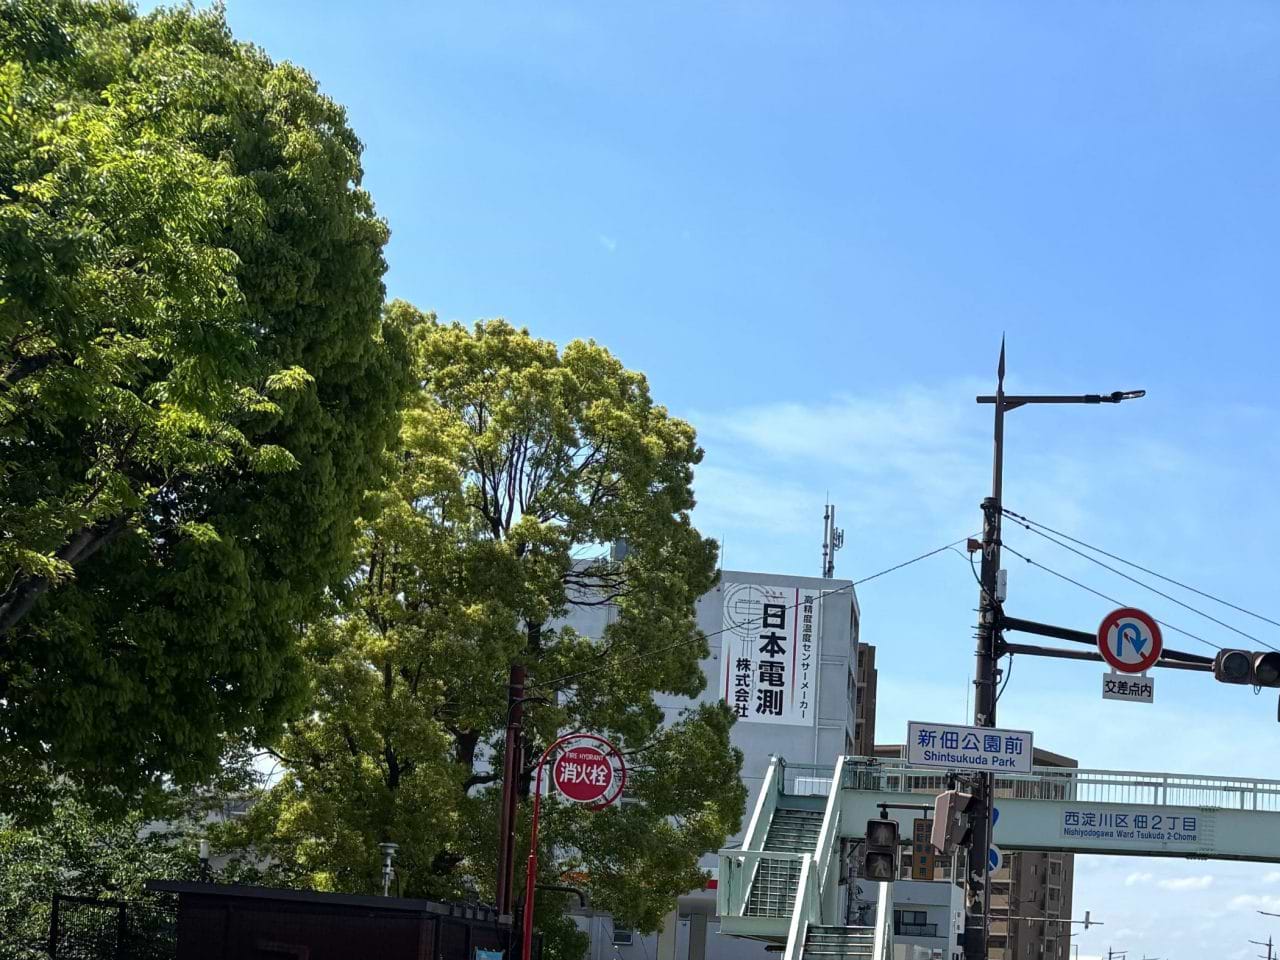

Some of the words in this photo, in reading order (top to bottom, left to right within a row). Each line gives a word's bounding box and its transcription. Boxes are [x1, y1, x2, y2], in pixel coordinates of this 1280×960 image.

[756, 603, 787, 716] 日本電測
[798, 595, 814, 719] 高精度温度センサーメーカー
[733, 657, 752, 718] 株式会社
[1105, 680, 1152, 697] 交差点内
[918, 729, 1023, 755] 新佃公園前
[924, 750, 988, 765] Shintsukuda
[992, 755, 1016, 767] Park
[560, 762, 608, 786] 消火栓
[1063, 827, 1114, 838] Nishiyodogawa
[1116, 829, 1134, 839] Ward
[1136, 830, 1165, 840] Tsukuda
[1166, 831, 1197, 842] 2-Chome
